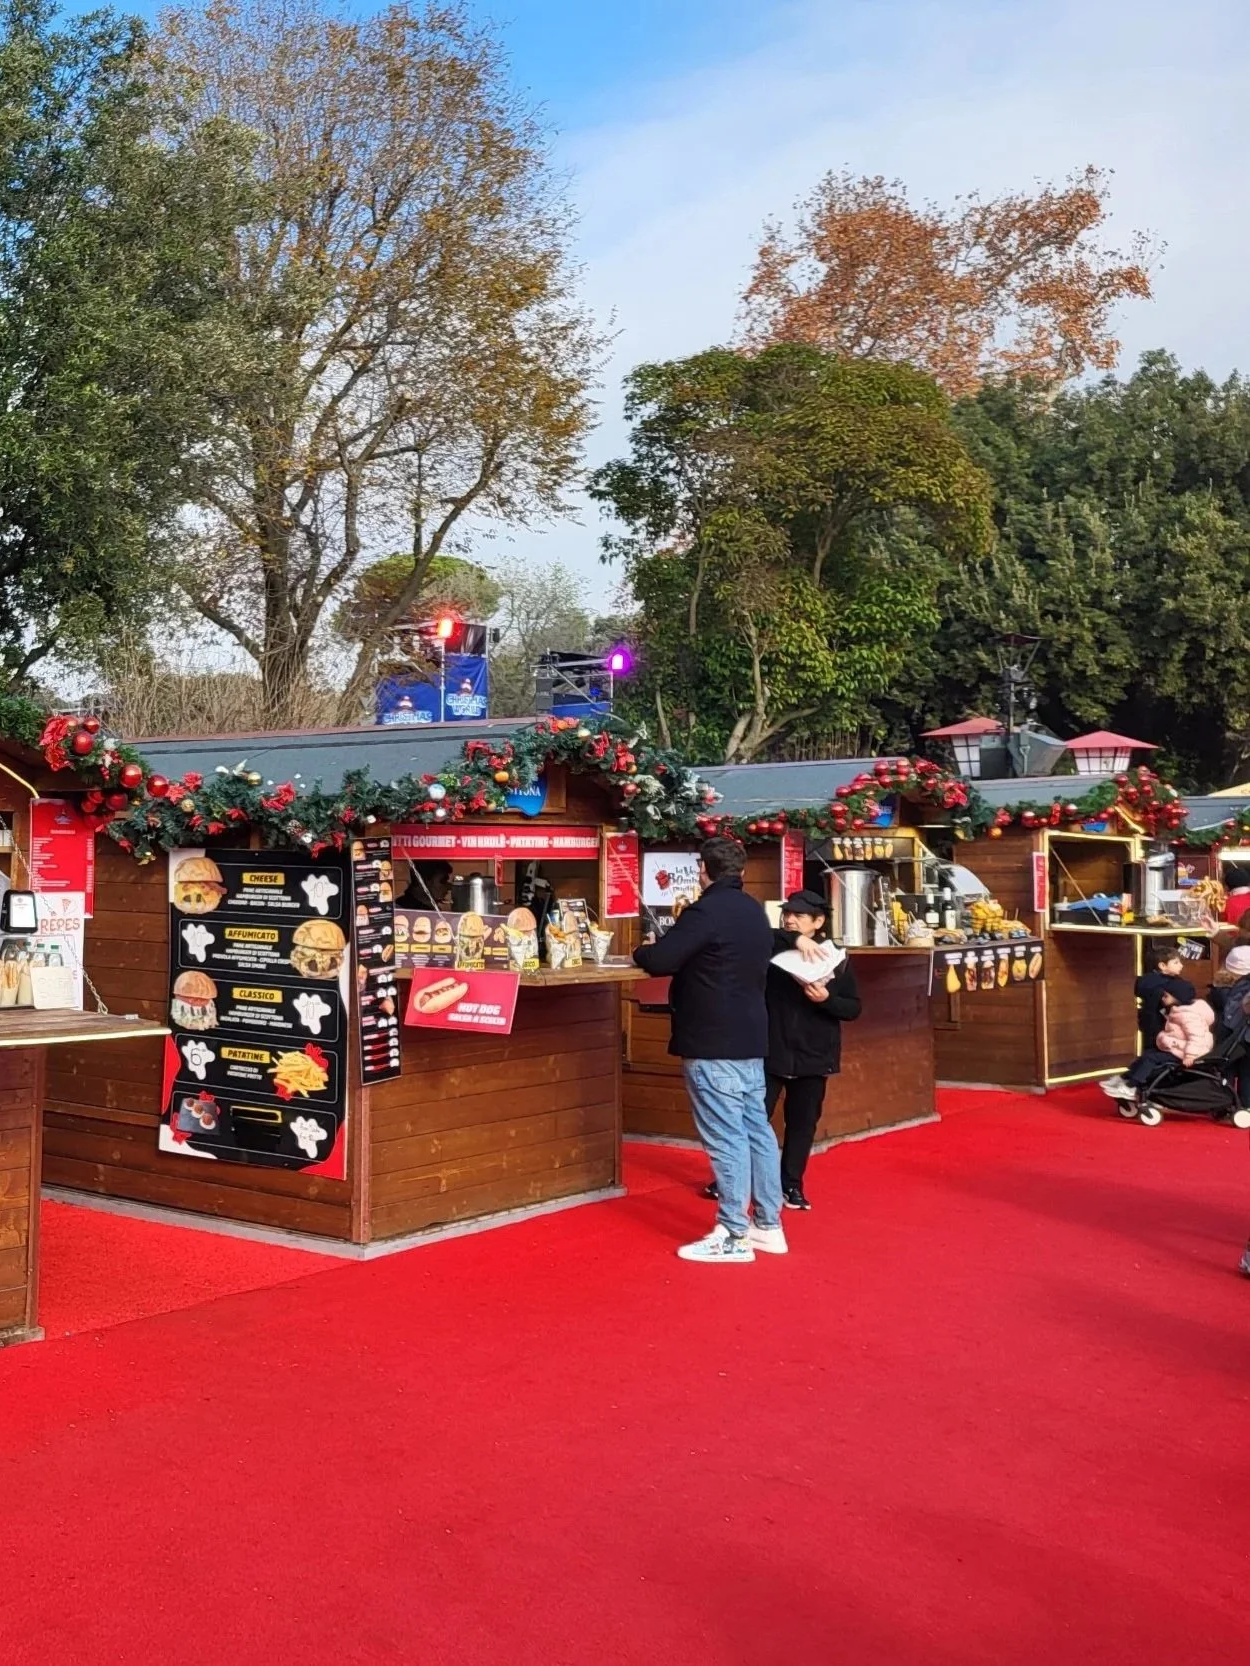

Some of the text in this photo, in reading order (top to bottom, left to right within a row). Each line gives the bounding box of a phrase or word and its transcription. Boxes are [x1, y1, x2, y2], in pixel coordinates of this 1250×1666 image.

[249, 874, 279, 883] CHEESE
[39, 918, 81, 933] REPES
[227, 929, 276, 940] AFFUMICATO
[239, 989, 275, 1000] CLASSICO
[479, 1003, 501, 1015] DOG
[227, 1049, 265, 1061] PATATINE
